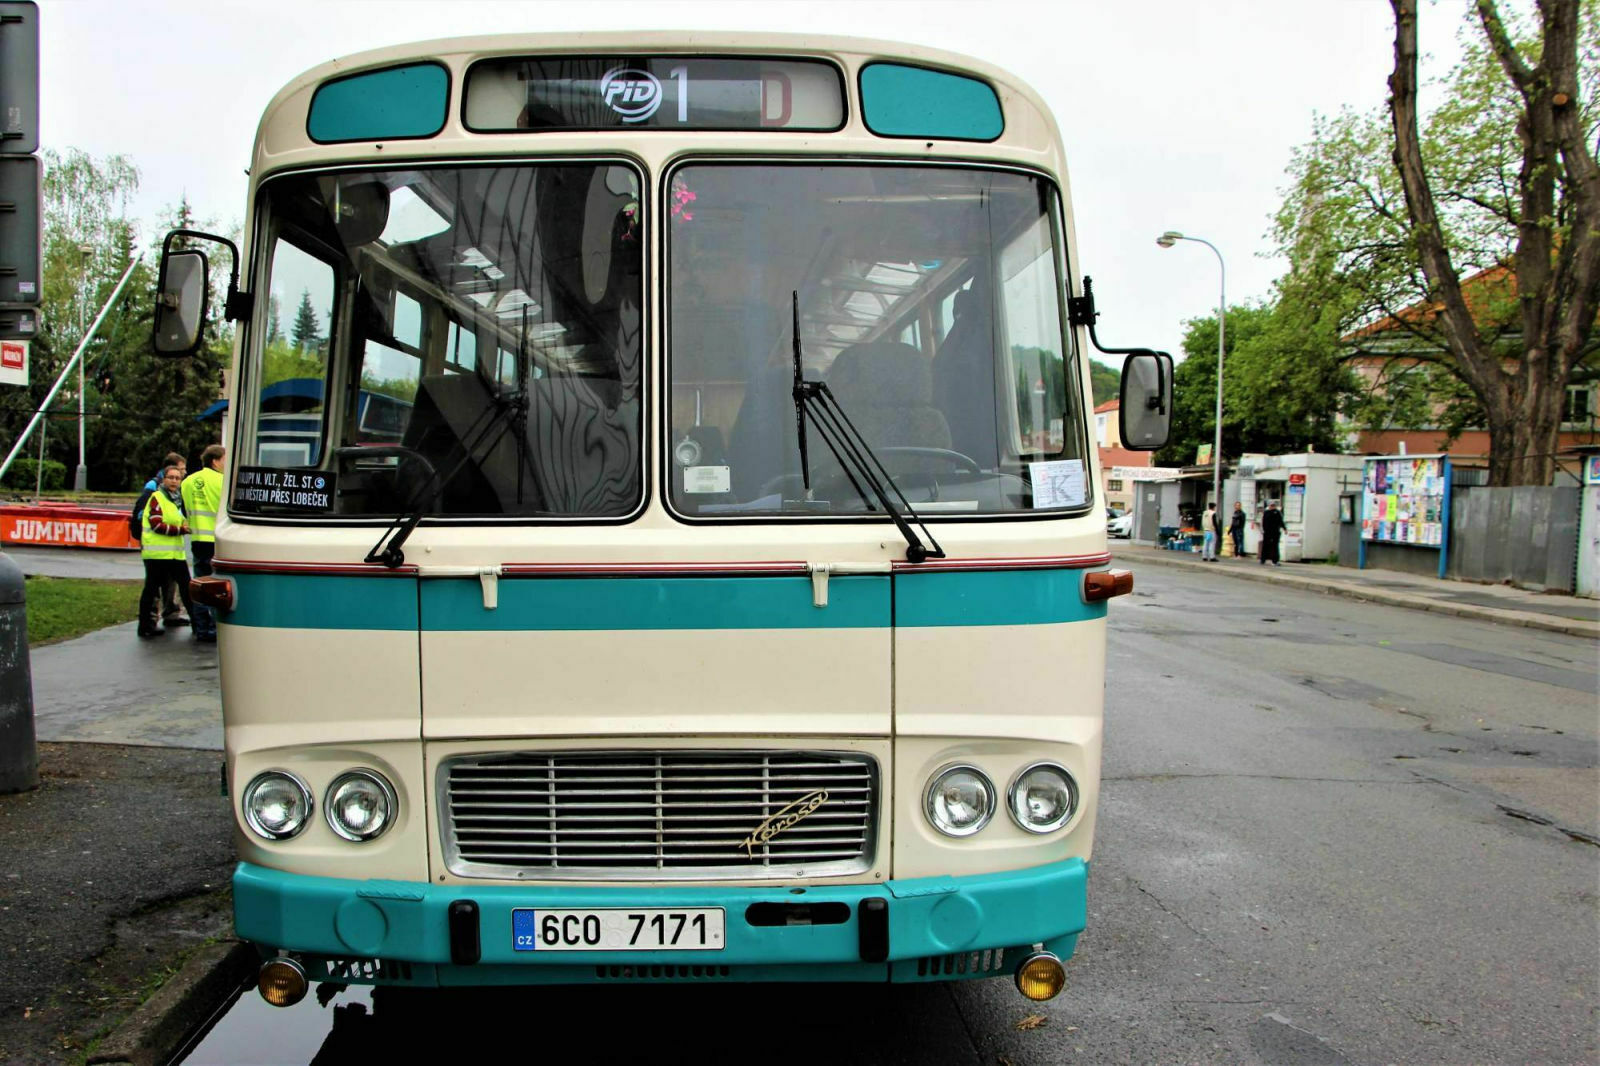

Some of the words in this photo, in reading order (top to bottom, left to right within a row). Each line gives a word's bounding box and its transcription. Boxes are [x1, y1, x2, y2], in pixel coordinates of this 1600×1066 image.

[670, 66, 688, 122] 1
[264, 473, 281, 487] VLT.,
[283, 472, 299, 488] ŽEL.
[301, 476, 314, 489] ST.
[270, 487, 290, 504] PŘES
[292, 491, 329, 507] LOBEČEK
[10, 519, 98, 543] JUMPING
[739, 788, 828, 860] Karosa
[517, 935, 533, 945] CZ
[628, 913, 706, 945] 7171
